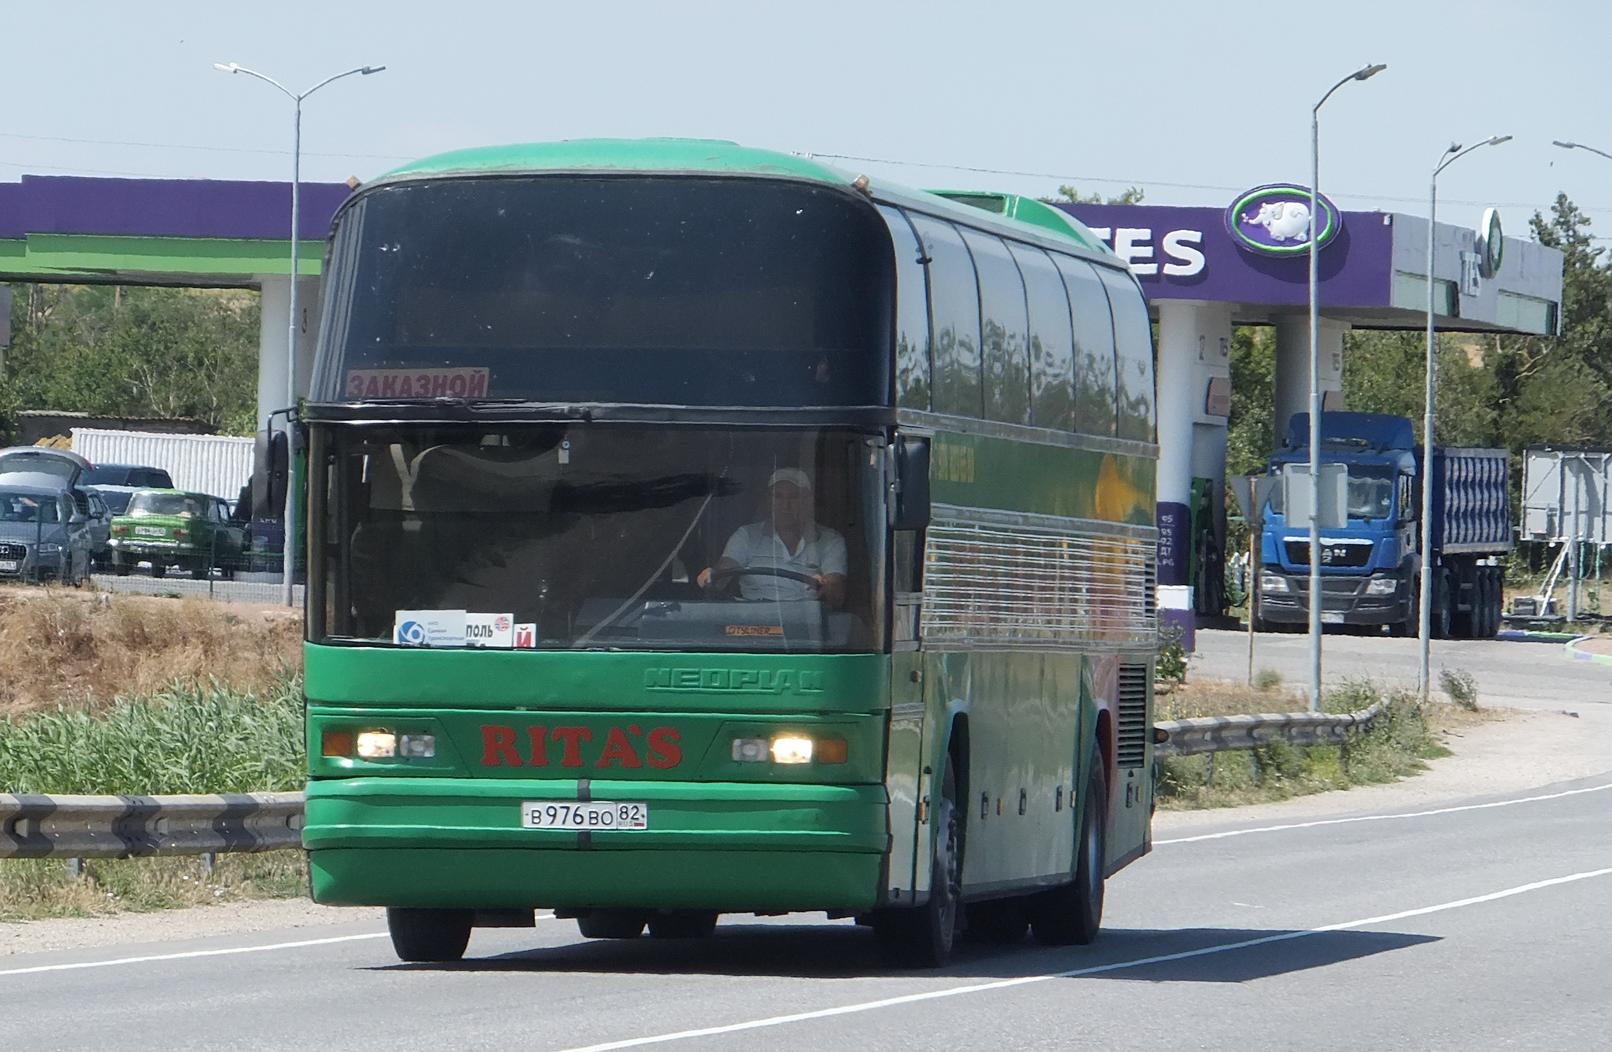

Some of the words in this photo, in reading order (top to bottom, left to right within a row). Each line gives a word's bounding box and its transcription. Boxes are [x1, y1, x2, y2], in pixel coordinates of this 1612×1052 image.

[348, 369, 486, 397] ЗАКАЗНОЙ
[1321, 548, 1347, 557] AN
[643, 667, 825, 692] NEOPLAN
[479, 724, 684, 769] RITA'S
[619, 806, 640, 821] 82
